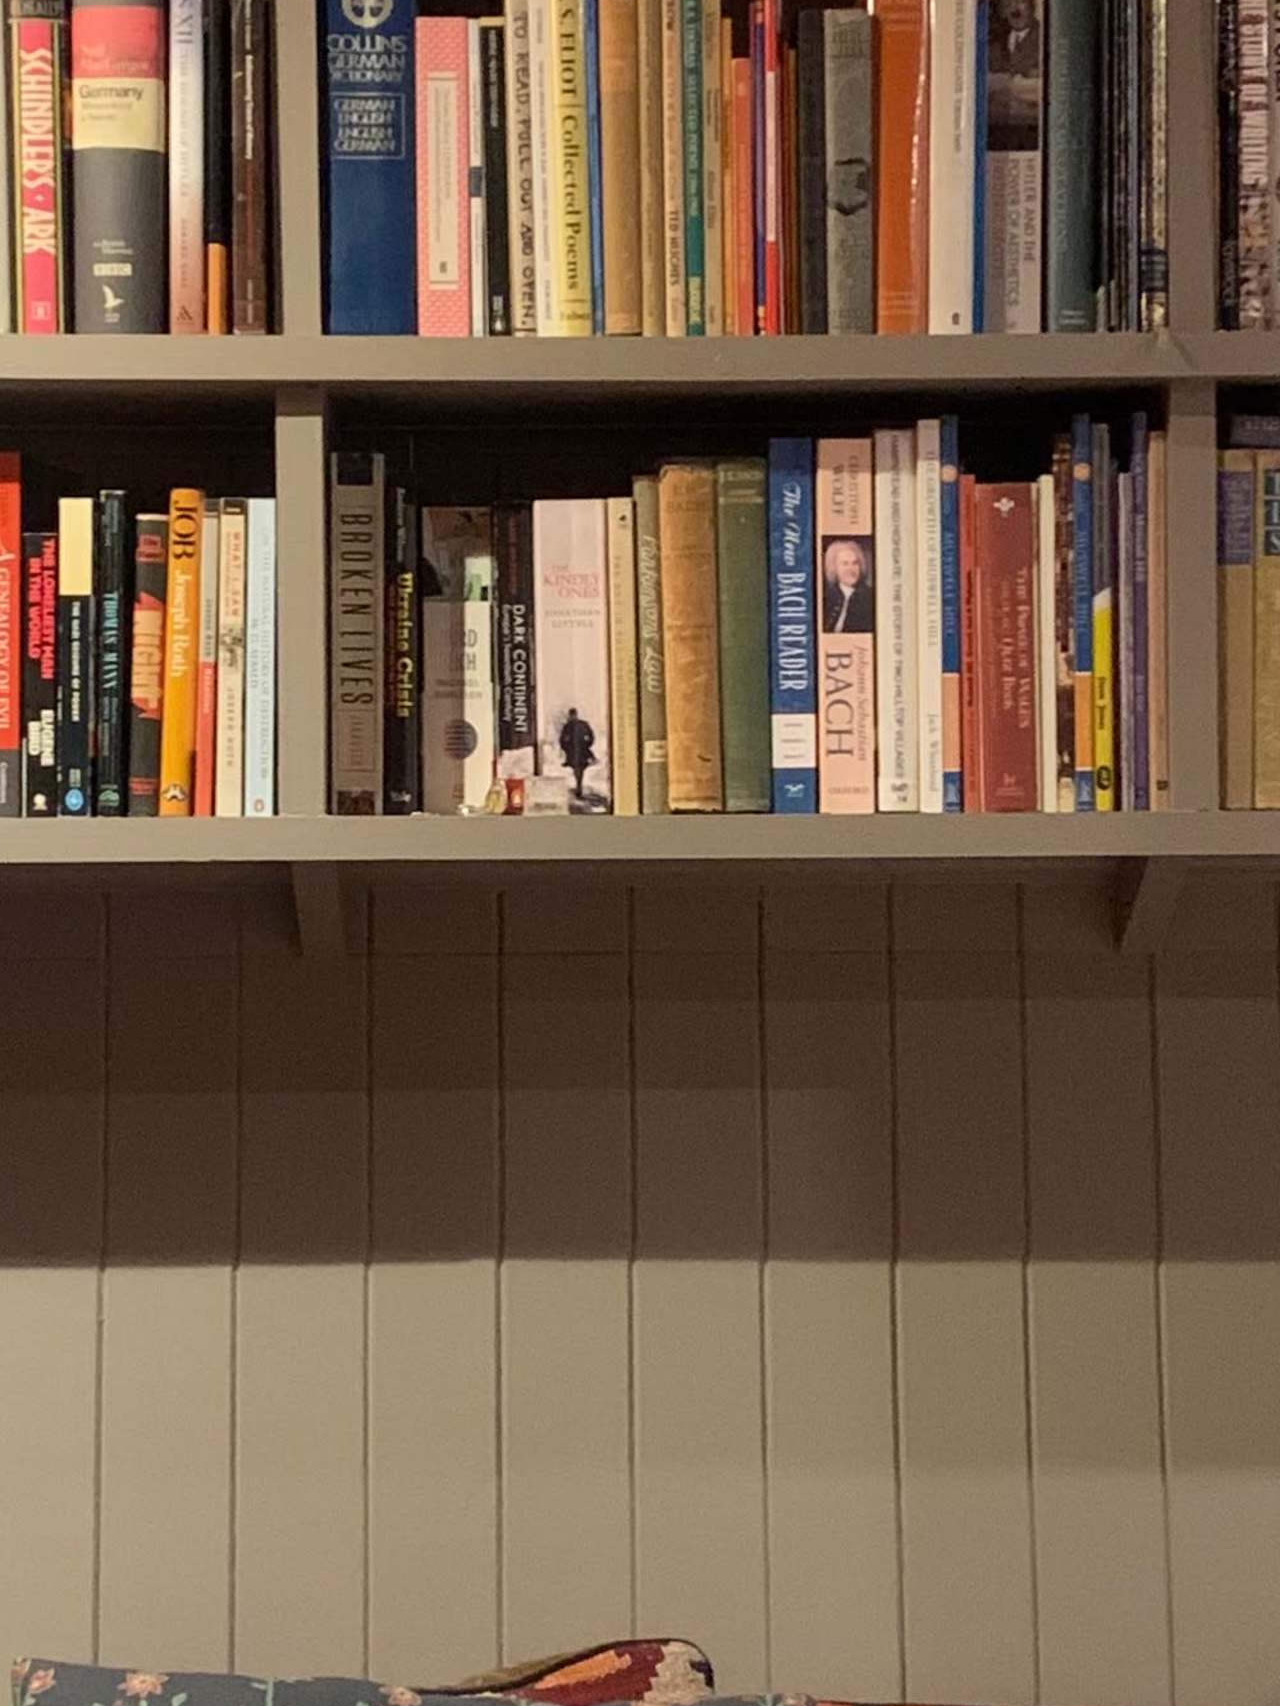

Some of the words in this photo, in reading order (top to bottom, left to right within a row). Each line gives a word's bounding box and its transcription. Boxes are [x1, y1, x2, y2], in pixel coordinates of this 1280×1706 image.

[79, 84, 144, 101] Germany
[333, 98, 396, 111] GERMAN
[337, 112, 392, 124] ENGLISH
[337, 126, 393, 139] ENGLISH
[333, 139, 396, 152] GERMAN
[1007, 158, 1022, 207] POWER
[1023, 158, 1038, 202] HITLER
[668, 209, 679, 234] TED
[1007, 211, 1022, 228] OF
[1023, 206, 1038, 236] AND
[669, 237, 680, 287] HUGHES
[1007, 233, 1023, 307] AESTHETICS
[1023, 239, 1038, 262] THE
[779, 481, 805, 519] The
[830, 463, 847, 519] WOLFF
[172, 499, 199, 560] JOB
[780, 520, 803, 567] New
[28, 557, 42, 574] IN
[41, 538, 56, 566] THE
[339, 513, 375, 615] BROKEN
[943, 532, 957, 595] MUSWELL
[28, 577, 42, 603] THE
[41, 568, 56, 642] LONELIEST
[171, 569, 192, 633] Joseph
[557, 586, 601, 599] ONES
[776, 572, 808, 618] BACH
[28, 605, 42, 659] WORLD
[512, 603, 527, 644] DARK
[944, 605, 958, 636] HILL
[41, 645, 56, 679] MAN
[169, 635, 190, 677] Roth
[339, 630, 374, 705] LIVES
[777, 624, 809, 691] READER
[856, 646, 872, 694] Johann
[513, 649, 529, 733] CONTINENT
[823, 652, 855, 757] BACH
[27, 721, 42, 756] BIRD
[40, 709, 56, 767] EUGENE
[856, 695, 872, 761] Sebastian
